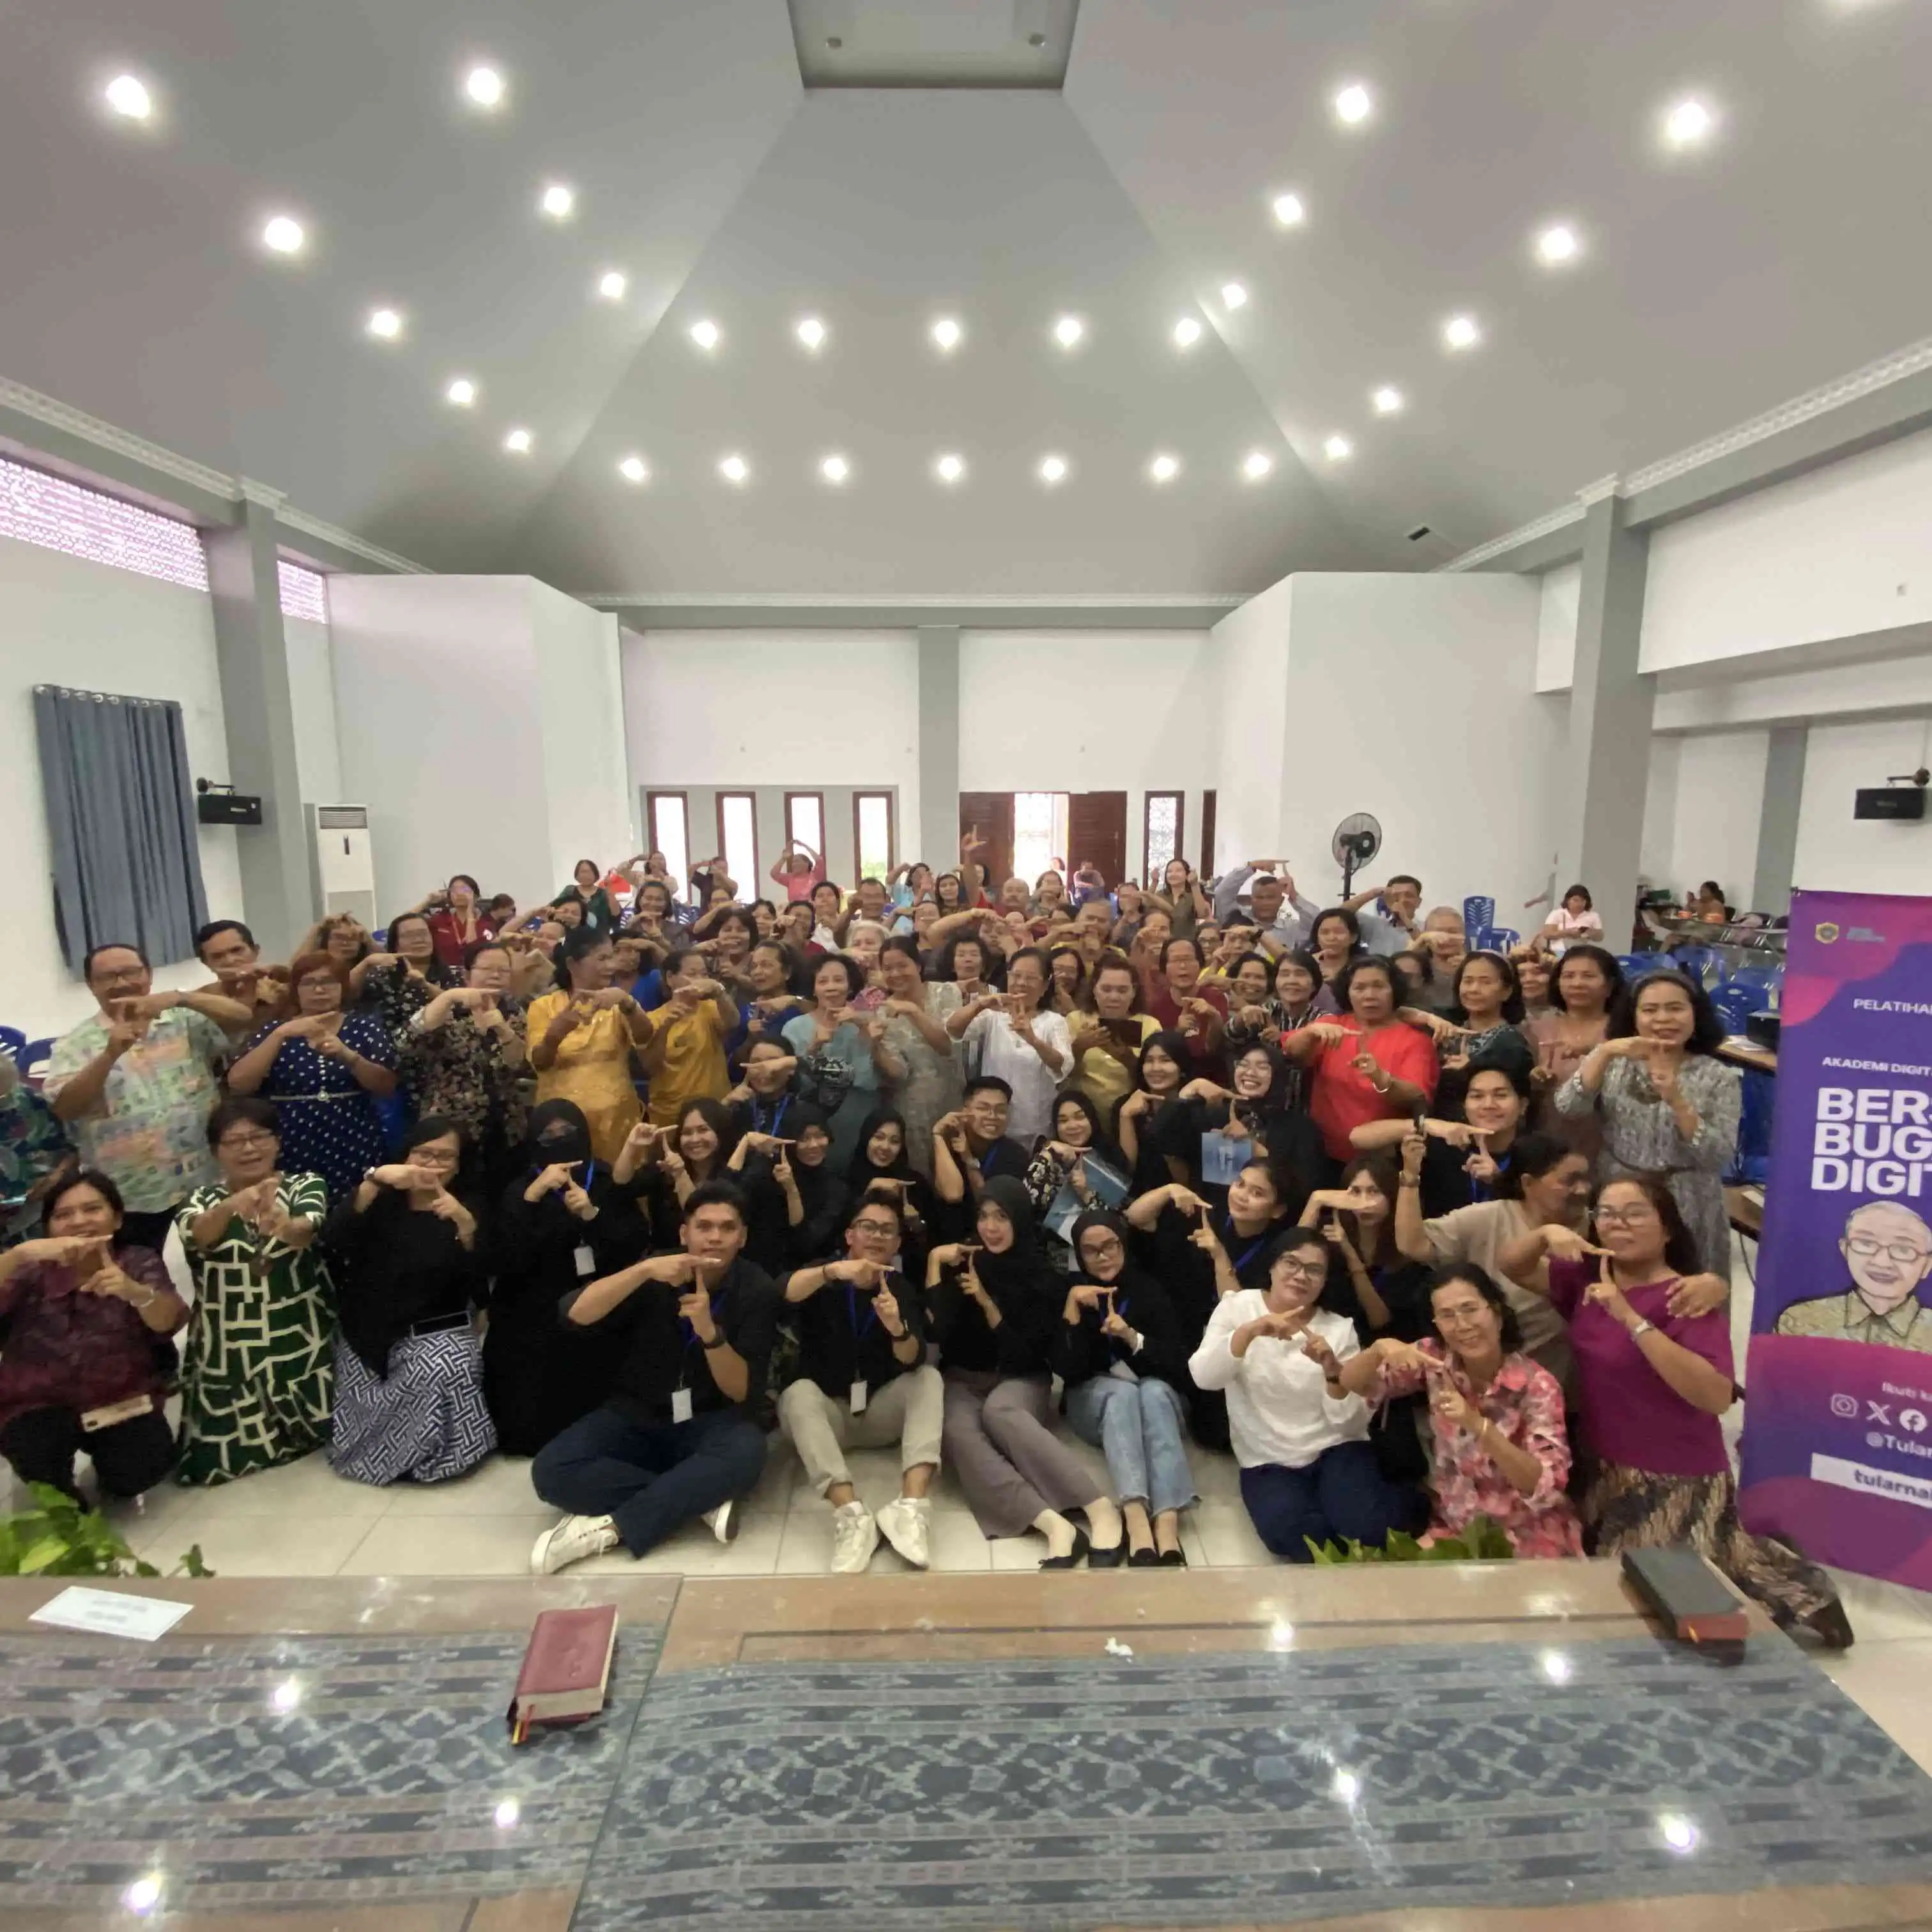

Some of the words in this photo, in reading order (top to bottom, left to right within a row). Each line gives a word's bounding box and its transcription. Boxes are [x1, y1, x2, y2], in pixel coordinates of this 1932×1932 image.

[1822, 1057, 1888, 1071] AKADEMI
[1890, 1063, 1932, 1076] DIGIT
[1817, 1087, 1932, 1124] BER
[1814, 1122, 1932, 1161] BUG
